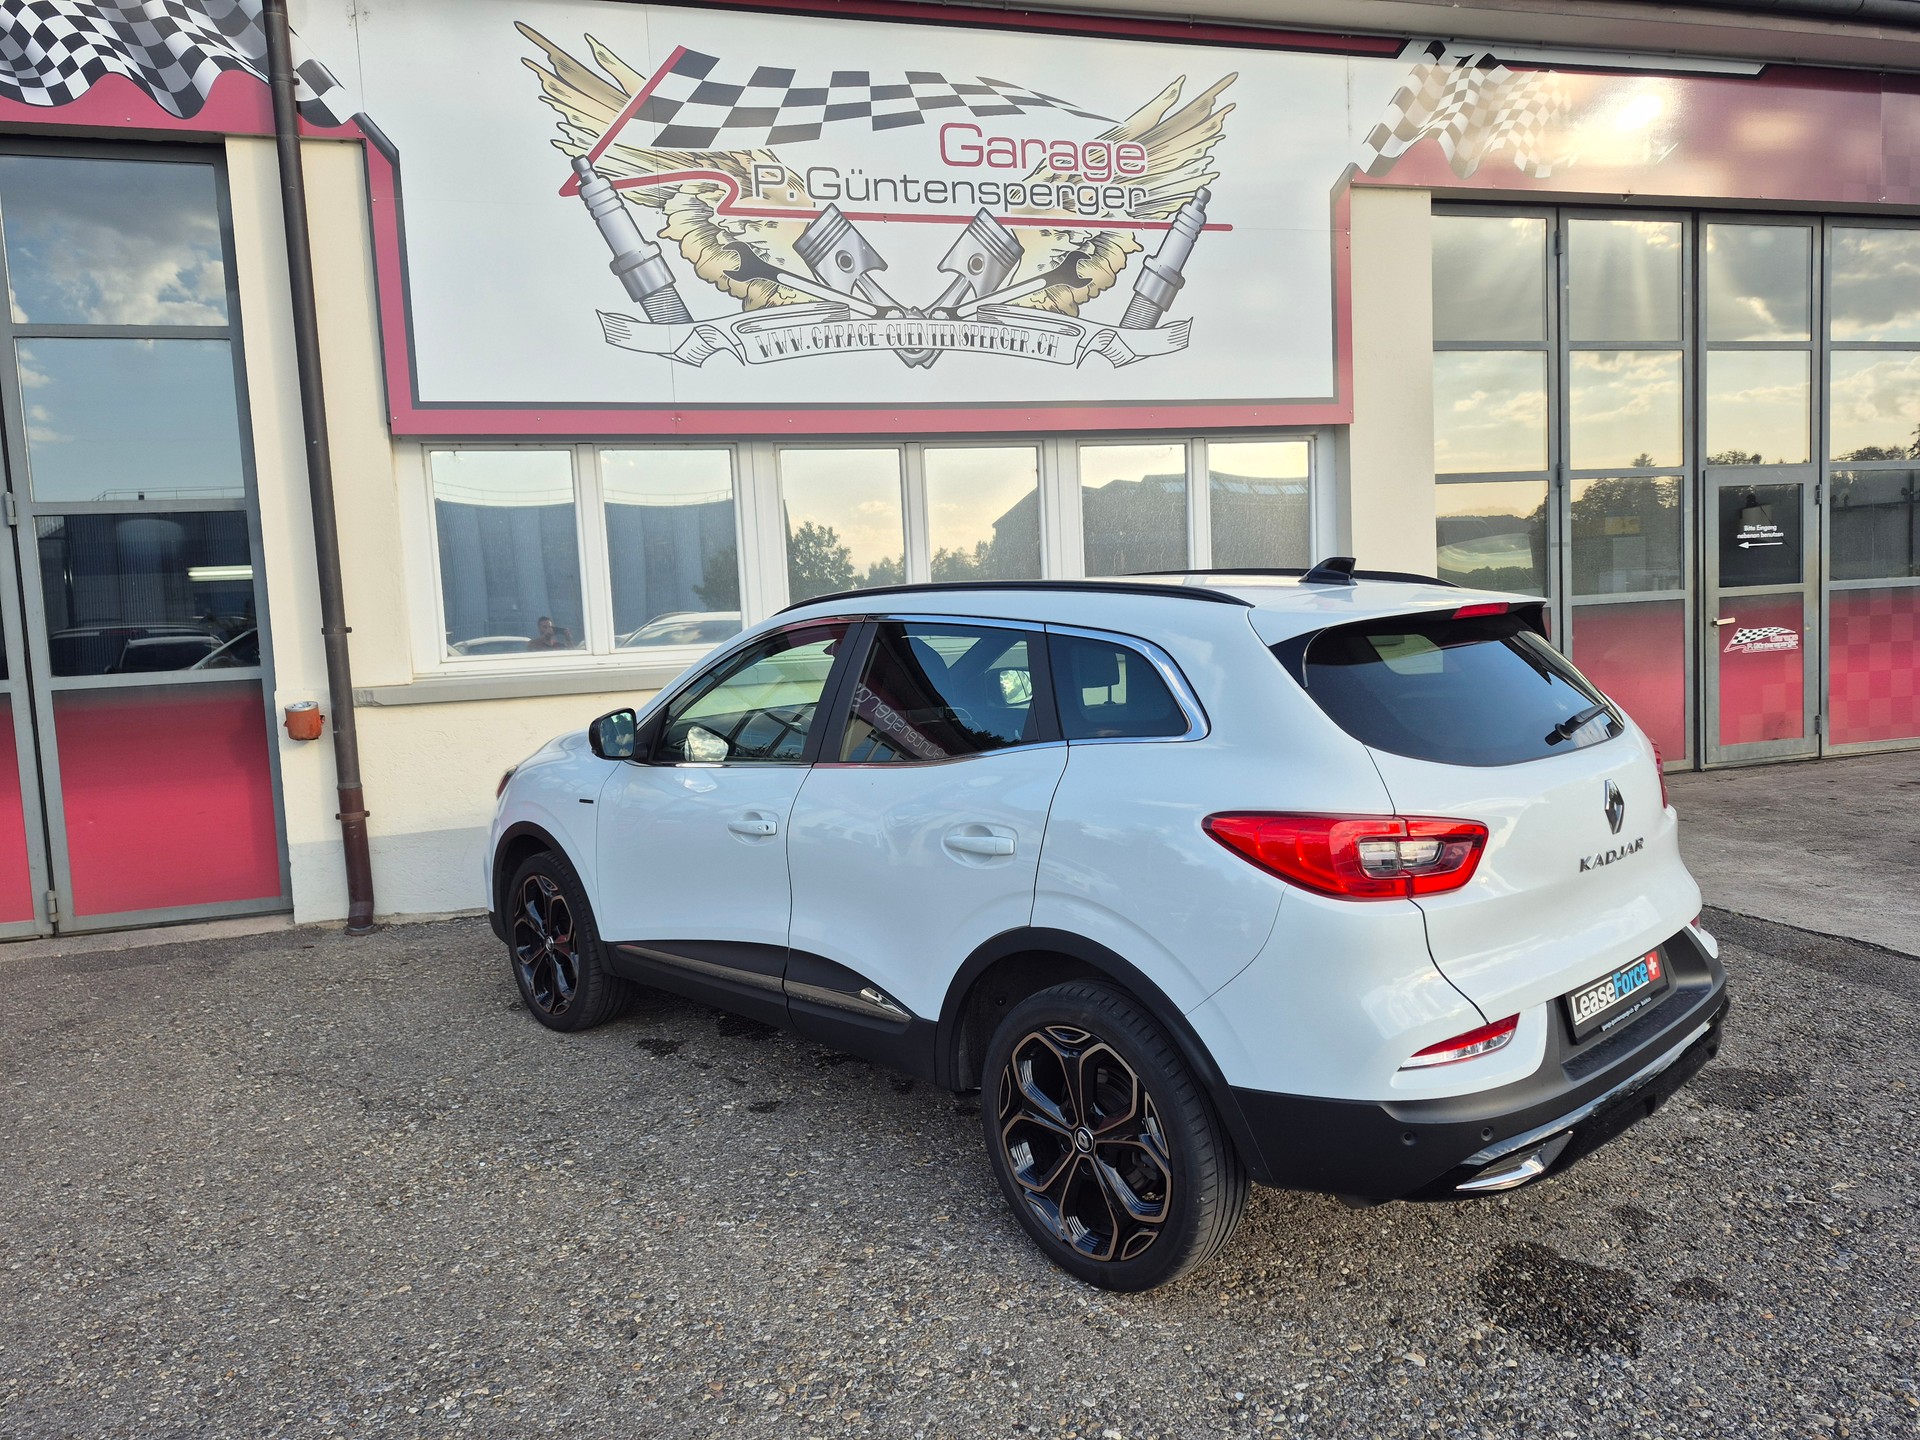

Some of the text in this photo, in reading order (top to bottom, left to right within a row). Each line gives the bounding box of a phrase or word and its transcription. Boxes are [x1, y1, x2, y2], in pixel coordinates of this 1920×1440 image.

[939, 122, 1147, 182] Garage
[753, 164, 1147, 215] P. Güntensperger
[754, 322, 1060, 359] WWW.GARAGE-GUENTENSPERGER.CH
[1579, 837, 1645, 873] KADJAR
[1571, 961, 1649, 1022] LeaseForce
